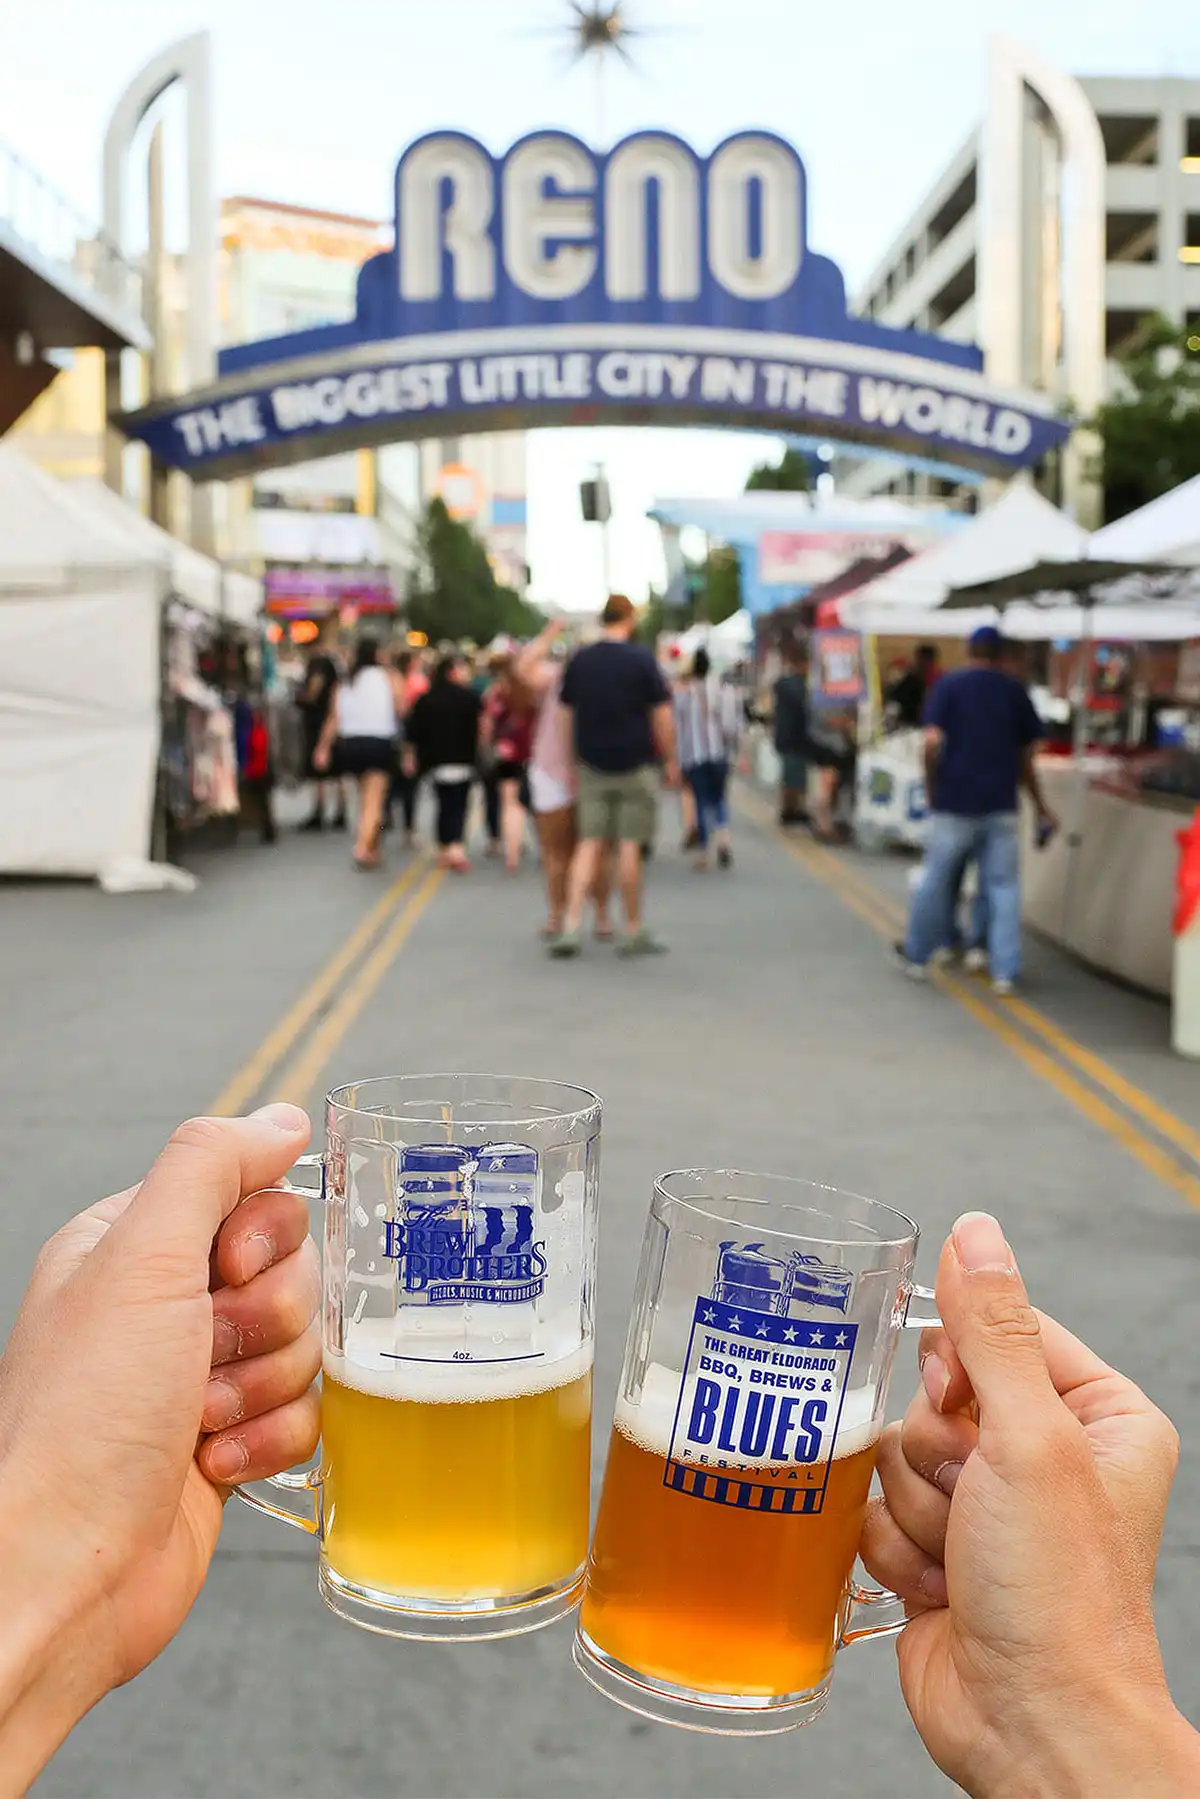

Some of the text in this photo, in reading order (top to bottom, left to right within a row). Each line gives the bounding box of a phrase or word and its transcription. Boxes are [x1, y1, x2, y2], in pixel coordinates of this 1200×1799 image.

[400, 138, 802, 302] RENO
[173, 350, 1031, 456] THE BIGGEST LITTLE CITY IN THE WORLD
[383, 1217, 475, 1259] BREW
[402, 1240, 547, 1293] BROTHERS
[460, 1286, 483, 1299] MUSIC
[699, 1356, 832, 1392] BBQ, BREWS &
[704, 1335, 836, 1371] THE GREAT ELDORADO
[687, 1377, 828, 1463] BLUES
[683, 1449, 815, 1480] FESTIVAL
